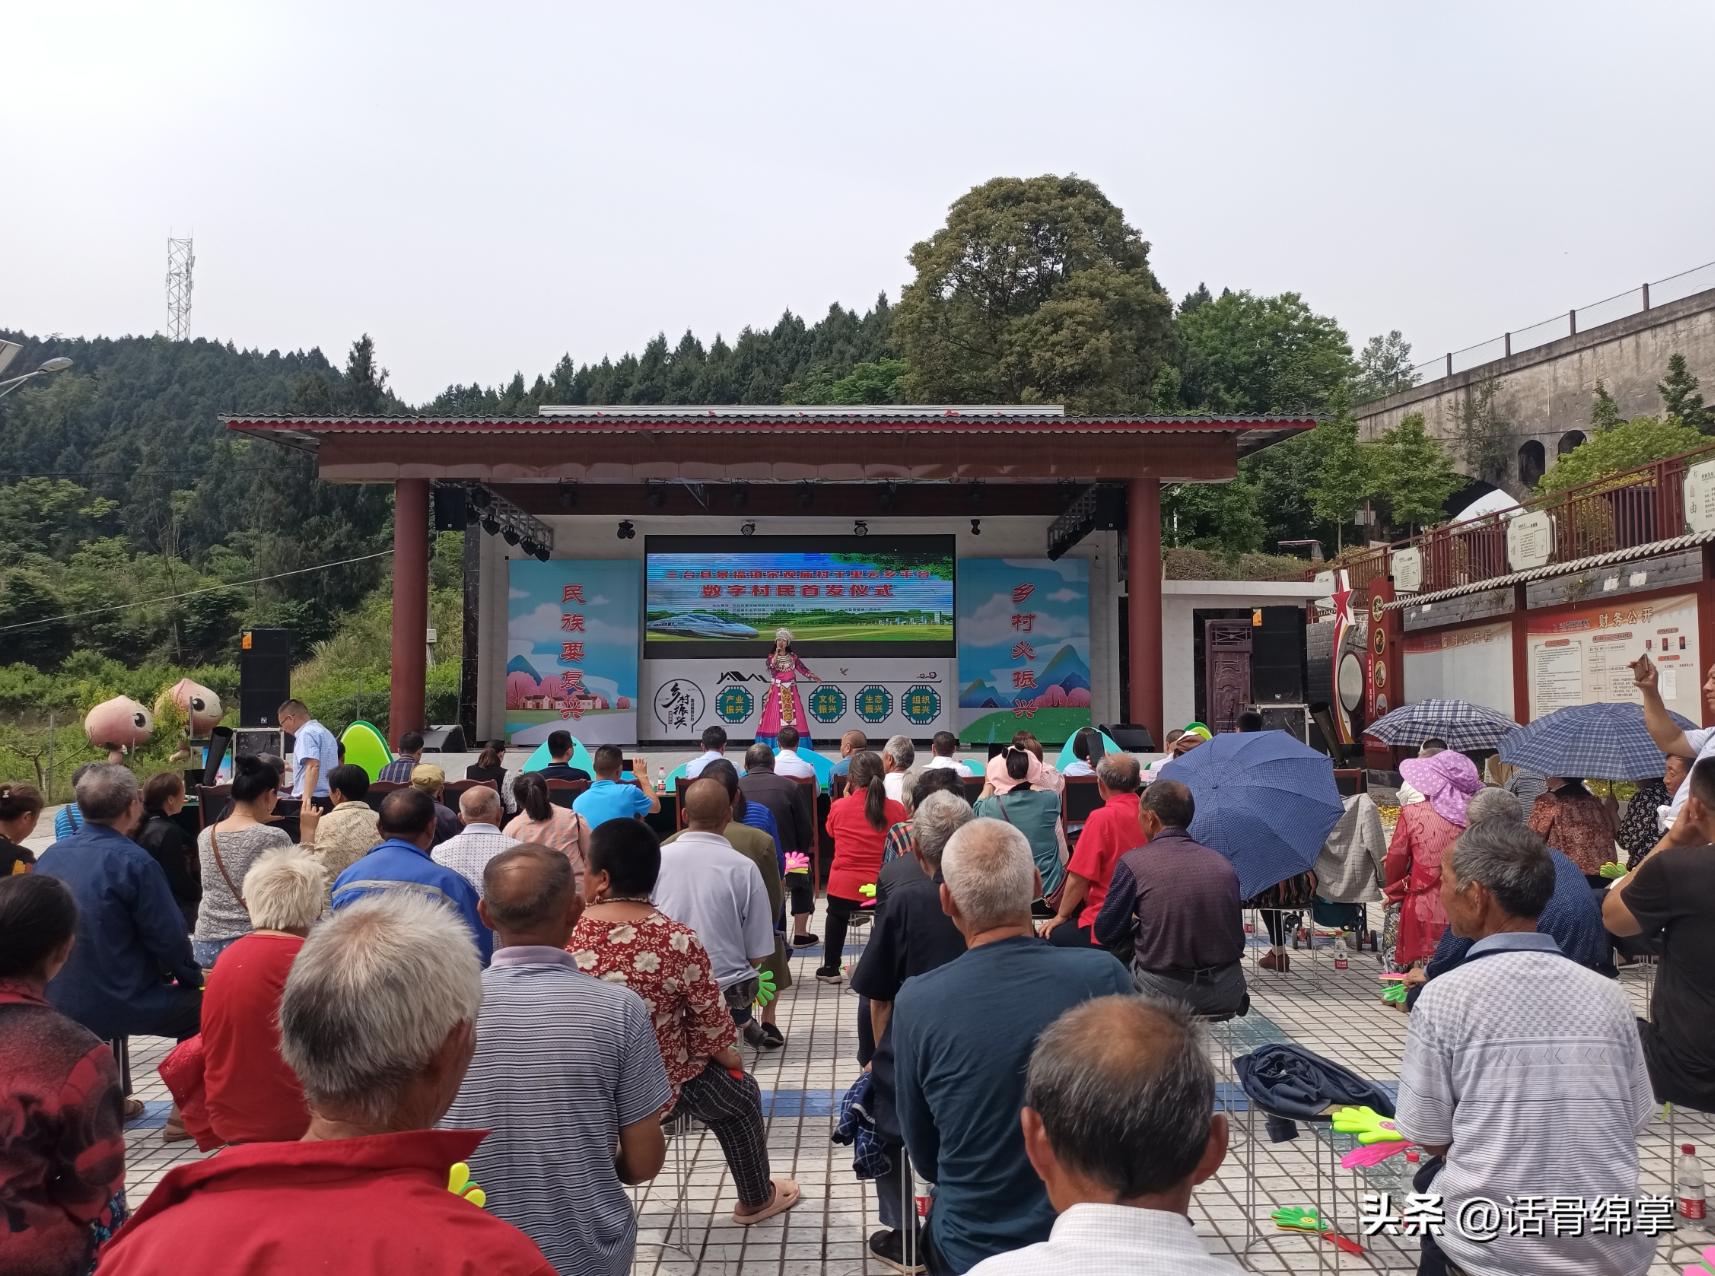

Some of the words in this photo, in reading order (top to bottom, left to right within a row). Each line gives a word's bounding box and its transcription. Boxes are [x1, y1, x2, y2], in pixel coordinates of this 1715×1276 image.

[700, 584, 896, 598] 数字村民首发仪式
[1598, 606, 1655, 629] 财务公开
[559, 583, 587, 720] 民族要复兴
[1011, 583, 1038, 719] 乡村必振兴
[726, 695, 744, 704] 产业
[818, 695, 837, 704] 文化
[865, 695, 883, 704] 生态
[912, 695, 930, 704] 组织
[661, 682, 690, 730] 乡村振兴
[726, 704, 744, 714] 振兴
[818, 704, 837, 714] 振兴
[864, 704, 883, 714] 振兴
[912, 705, 930, 714] 振兴
